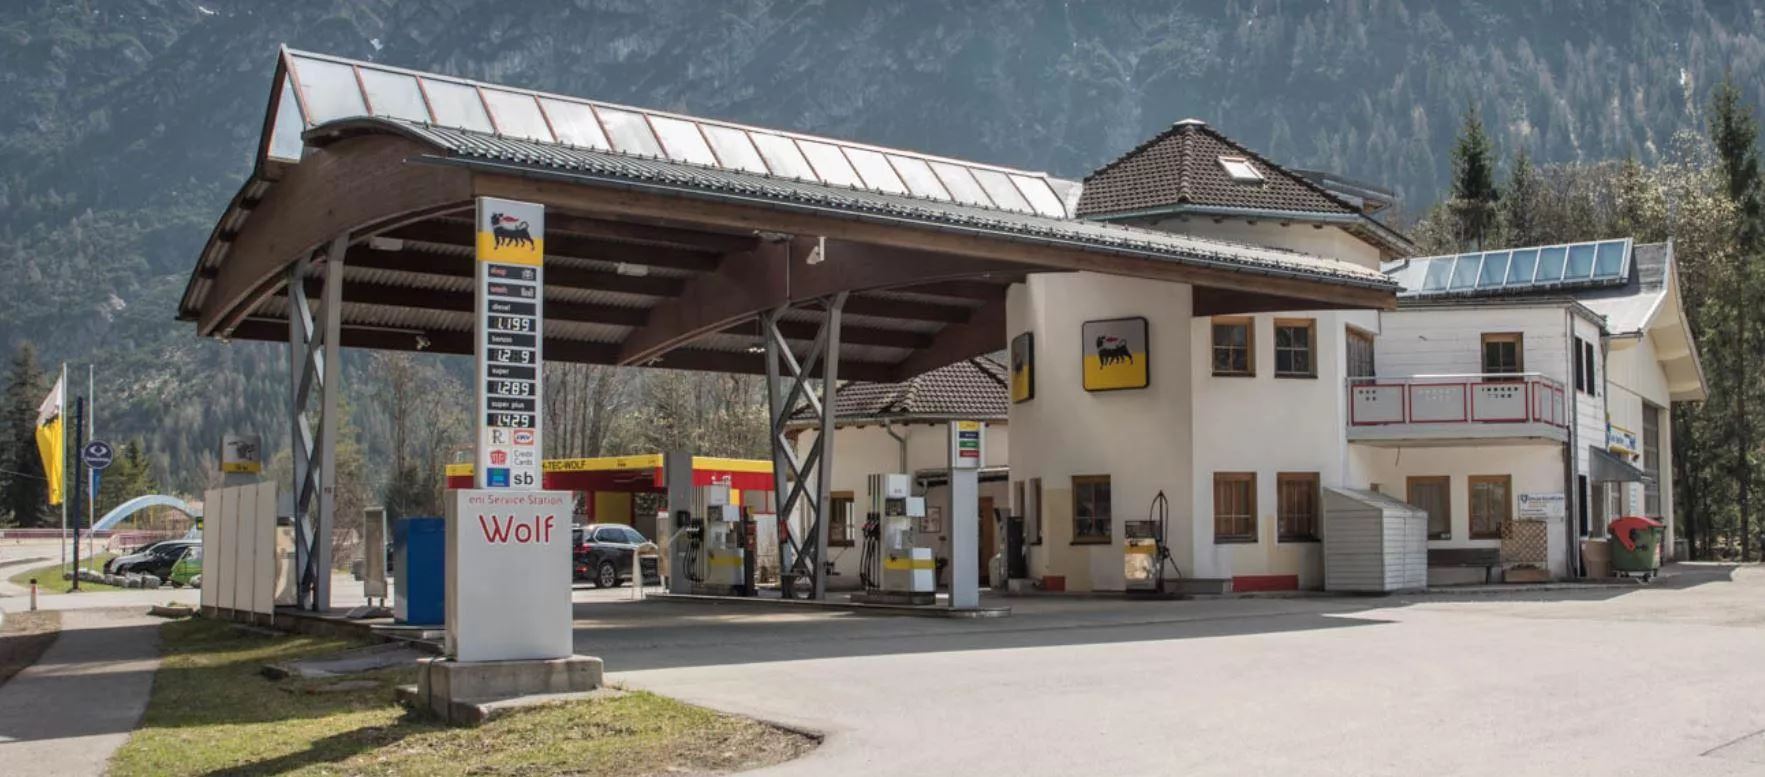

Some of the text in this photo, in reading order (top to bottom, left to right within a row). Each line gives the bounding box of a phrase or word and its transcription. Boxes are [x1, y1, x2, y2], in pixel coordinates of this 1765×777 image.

[492, 303, 511, 312] diesel
[513, 458, 533, 466] Cards
[514, 471, 534, 485] sb
[469, 494, 563, 506] eni Service Station
[479, 514, 555, 543] Wolf
